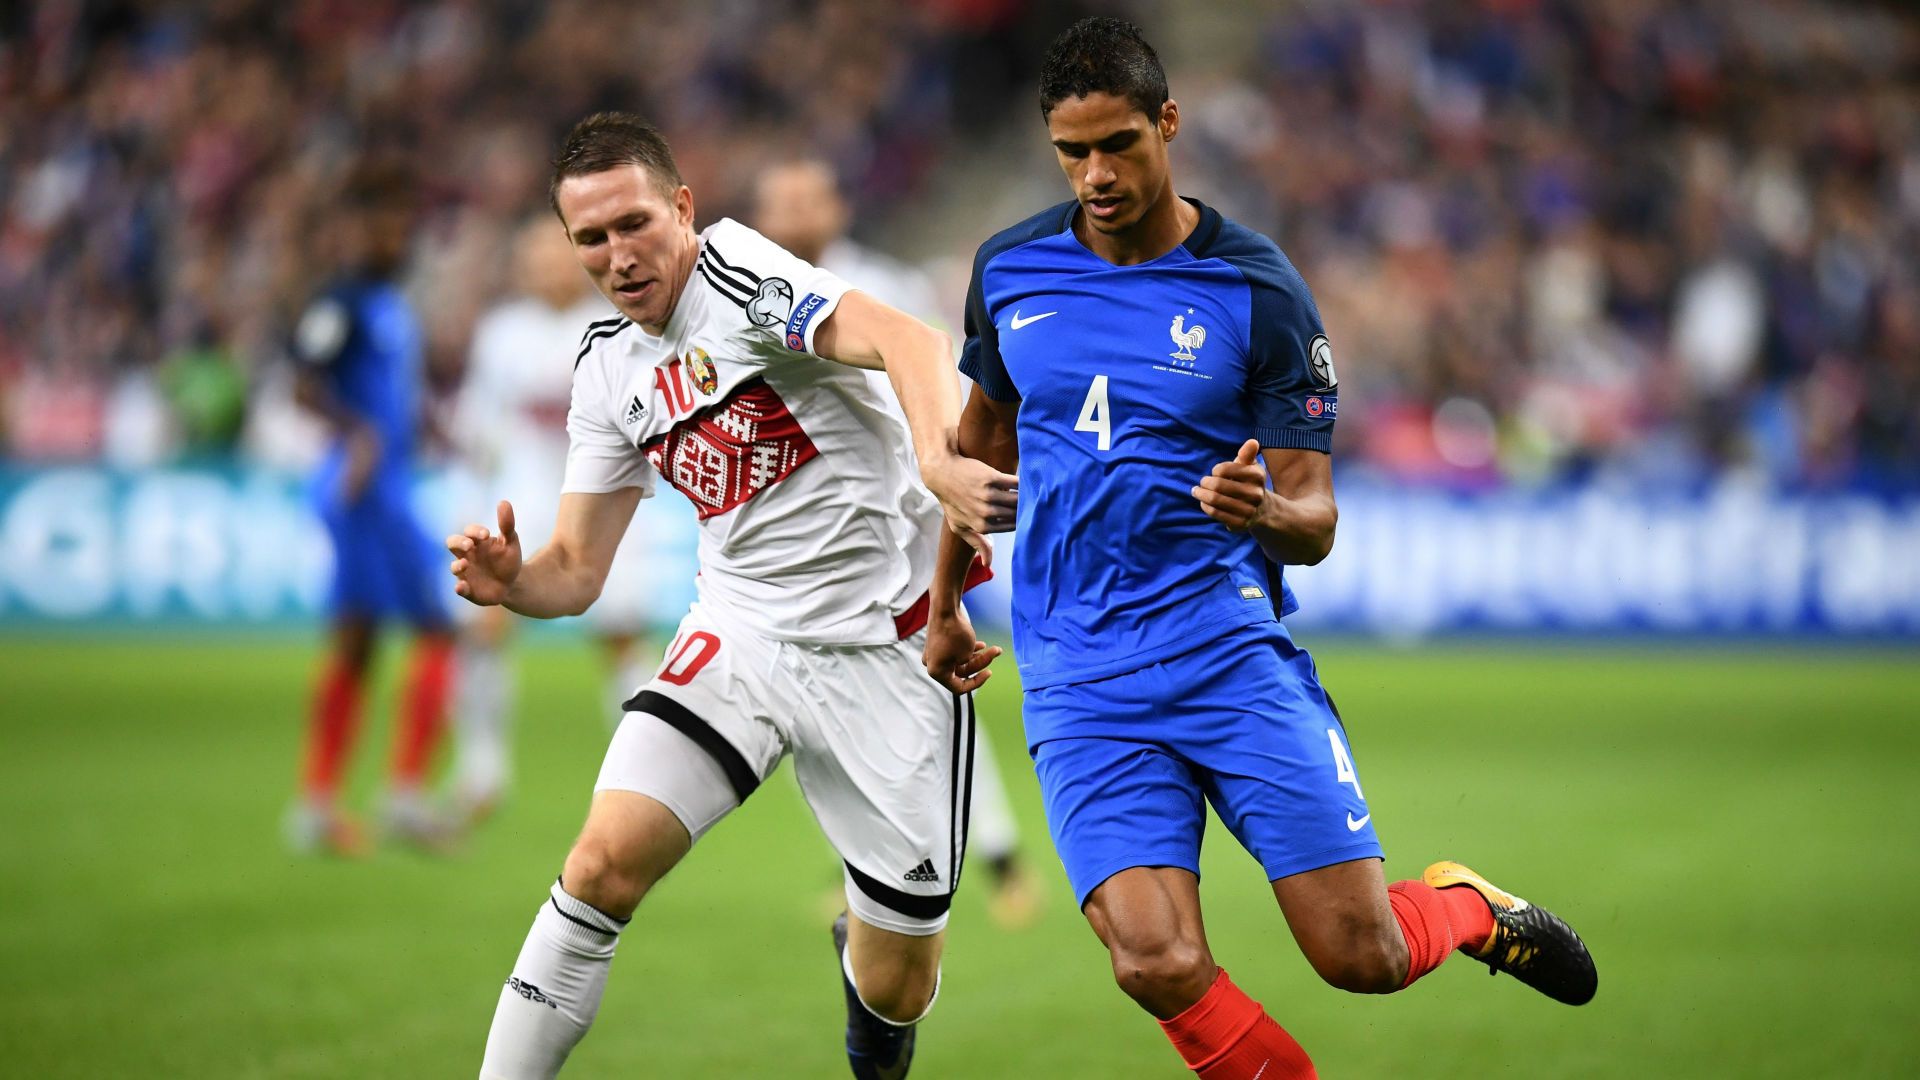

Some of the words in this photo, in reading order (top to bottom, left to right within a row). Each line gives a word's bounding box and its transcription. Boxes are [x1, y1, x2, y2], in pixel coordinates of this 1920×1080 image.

[791, 294, 823, 333] RESPECT
[626, 409, 649, 425] adidas
[655, 358, 696, 420] 10
[1074, 375, 1111, 451] 4
[657, 626, 721, 687] 0
[1327, 728, 1365, 800] 4
[903, 872, 939, 882] adidas
